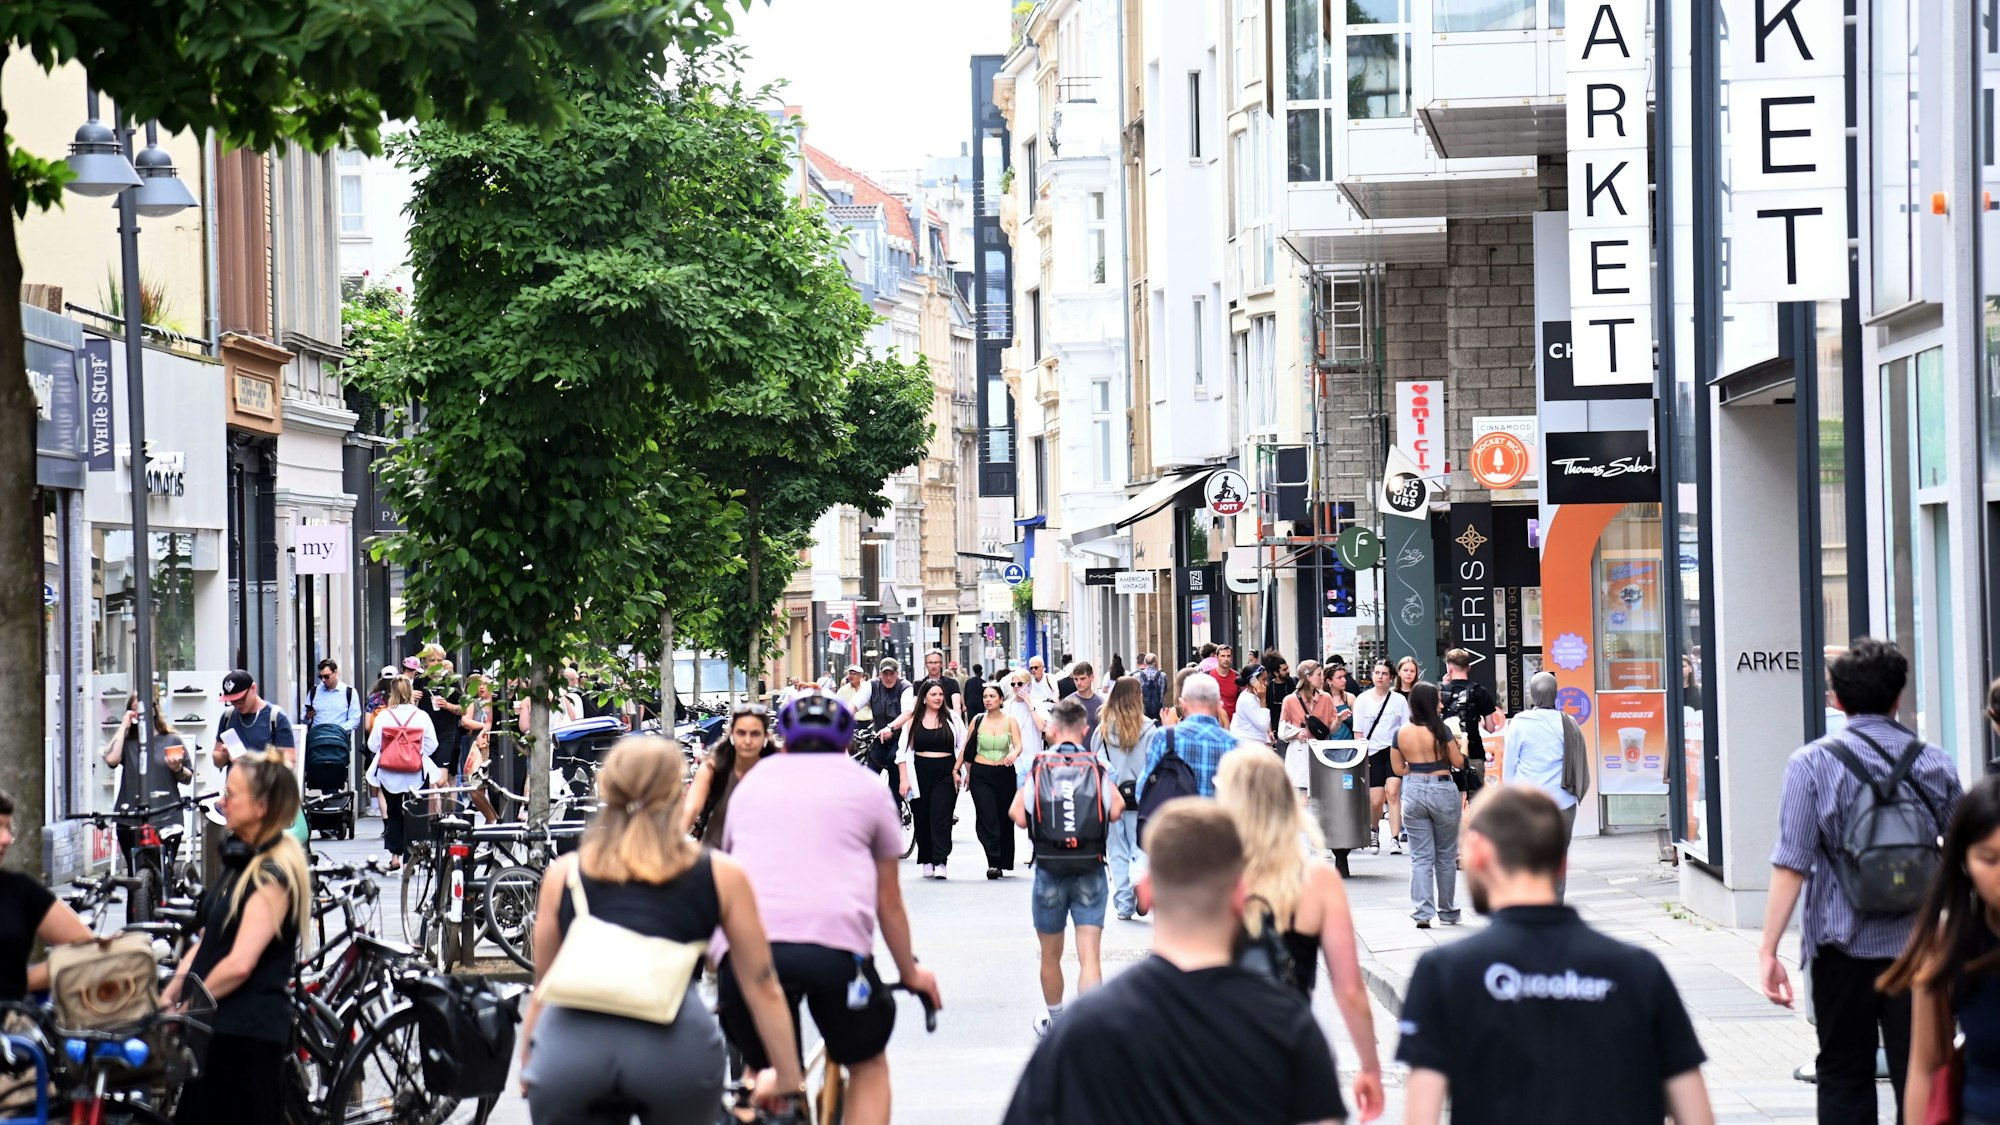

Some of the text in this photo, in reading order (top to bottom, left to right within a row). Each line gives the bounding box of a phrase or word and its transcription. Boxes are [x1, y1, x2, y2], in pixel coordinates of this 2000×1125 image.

[1581, 4, 1636, 373] ARKET
[1475, 437, 1522, 455] ROCKET RICE
[1551, 457, 1656, 477] Thomas Sabo
[1217, 503, 1239, 511] JOTT
[1392, 495, 1416, 507] URS
[1508, 586, 1518, 604] be
[1460, 560, 1487, 667] VERIS
[1508, 607, 1519, 635] true
[1509, 641, 1520, 653] to
[1737, 651, 1803, 671] ARKE
